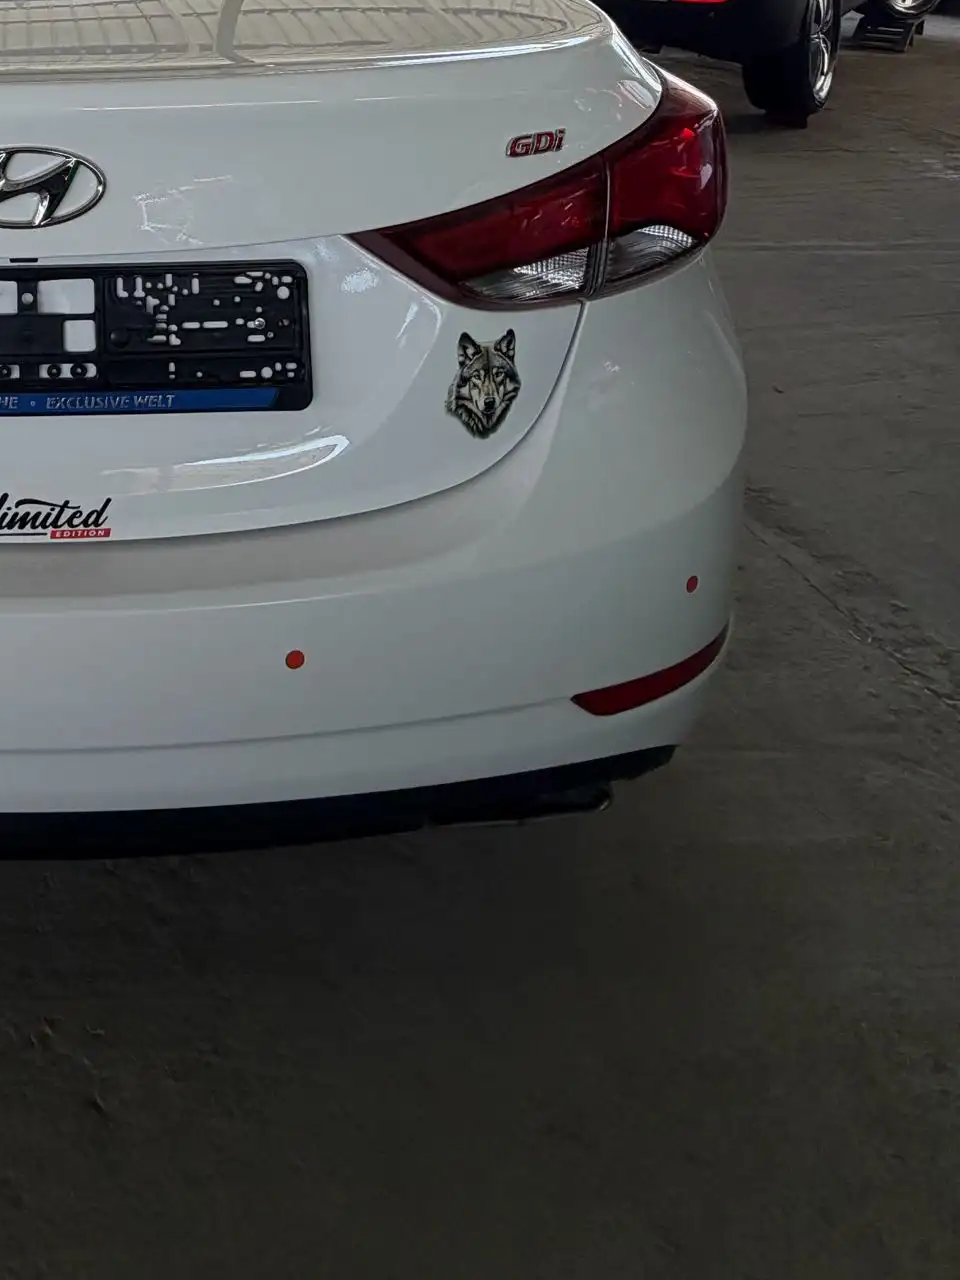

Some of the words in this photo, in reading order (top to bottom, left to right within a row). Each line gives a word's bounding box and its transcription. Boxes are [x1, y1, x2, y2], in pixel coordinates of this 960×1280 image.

[505, 127, 566, 157] GDi
[46, 395, 130, 409] EXCLUSIVE
[133, 394, 176, 408] WELT
[55, 529, 106, 538] EDITION
